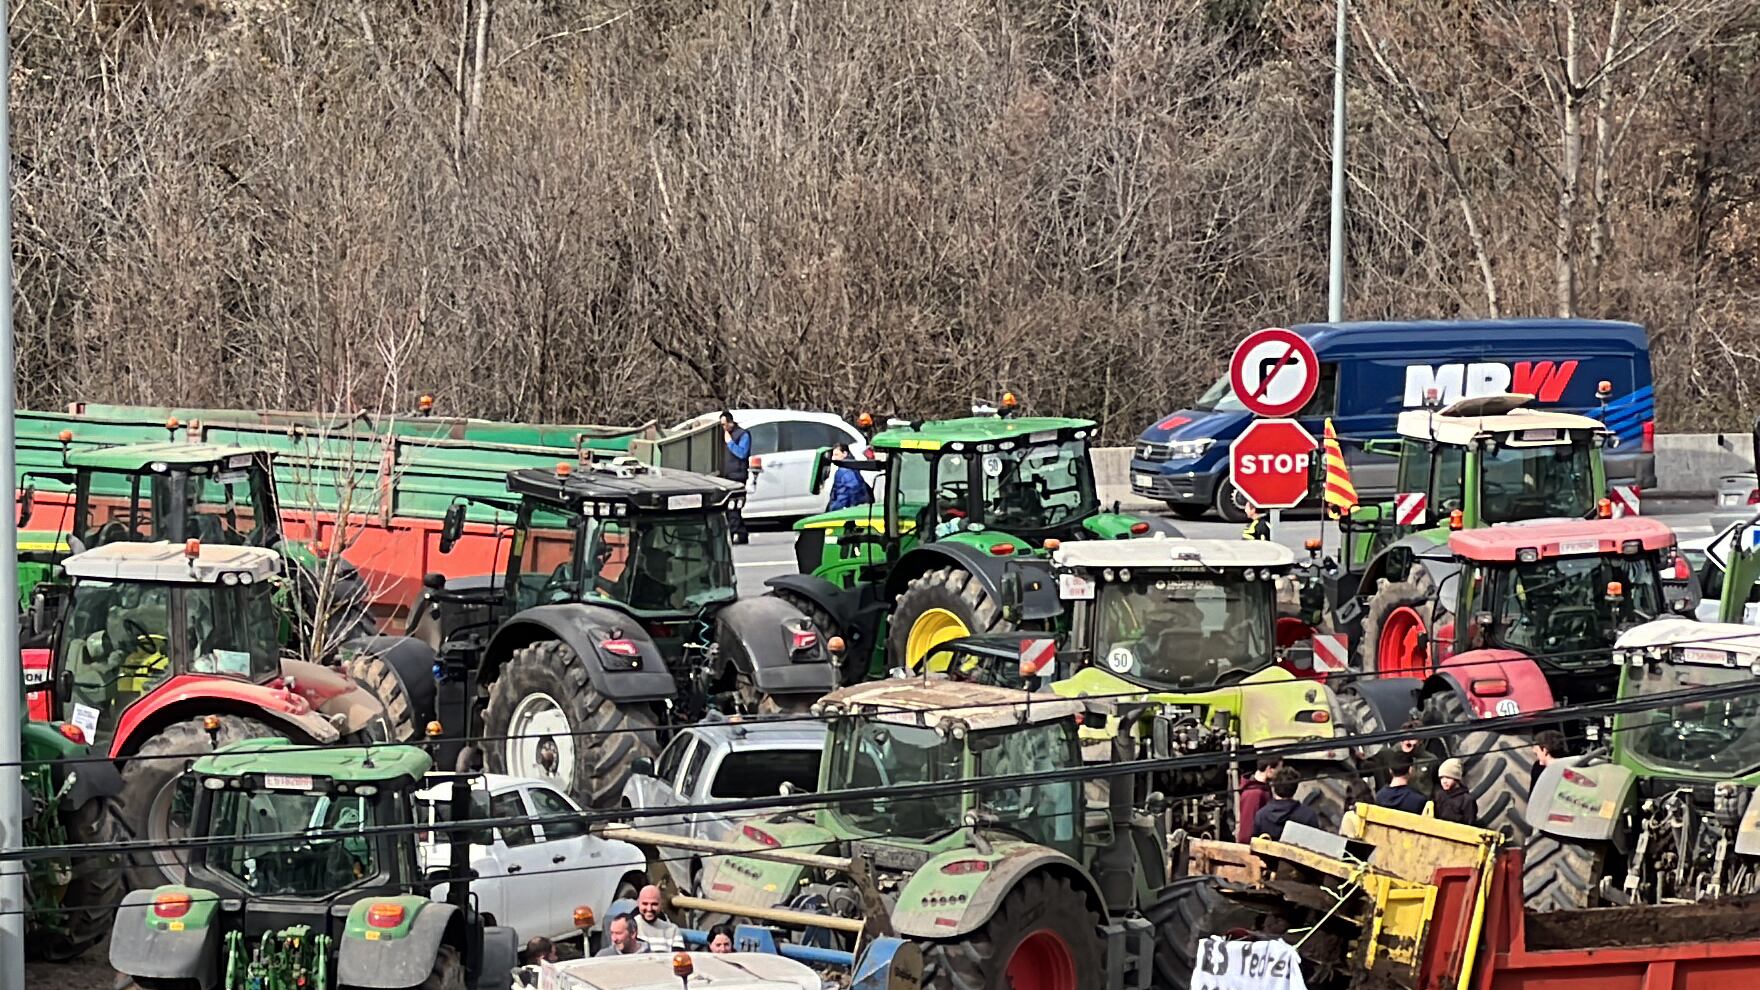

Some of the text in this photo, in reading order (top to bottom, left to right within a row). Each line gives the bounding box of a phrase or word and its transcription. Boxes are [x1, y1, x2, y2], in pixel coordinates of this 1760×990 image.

[987, 458, 999, 472] 50
[1240, 453, 1309, 475] STOP
[1113, 653, 1129, 668] 50
[1500, 701, 1516, 717] 40
